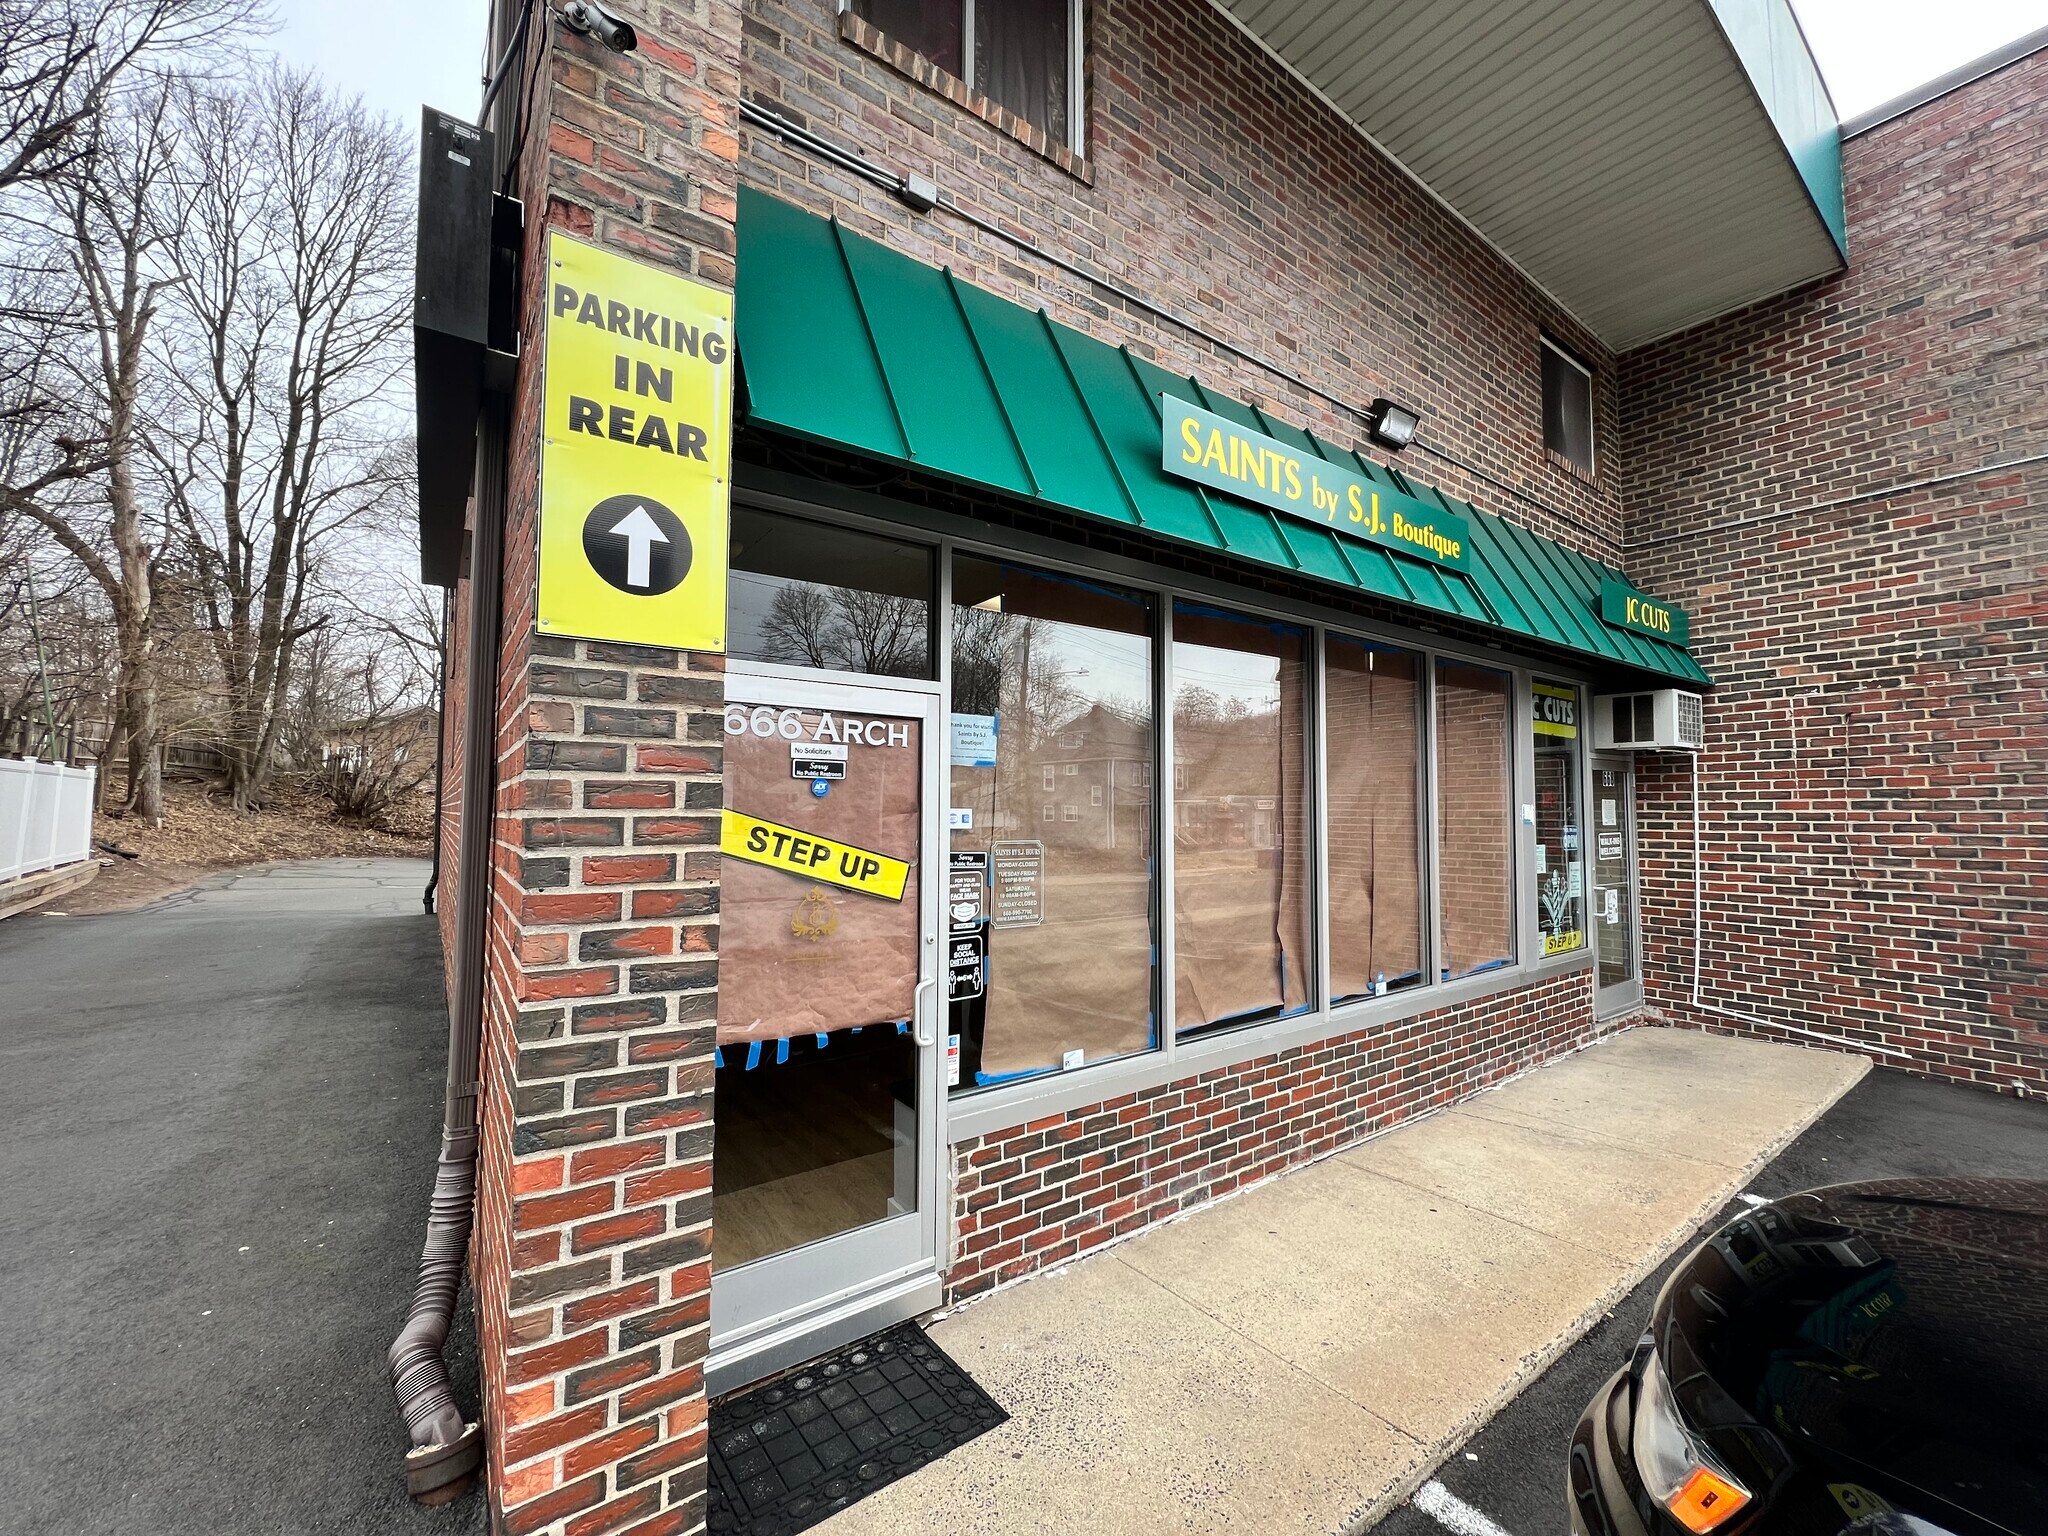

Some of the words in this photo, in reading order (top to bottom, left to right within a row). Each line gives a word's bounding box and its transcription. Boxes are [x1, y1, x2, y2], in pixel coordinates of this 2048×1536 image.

[554, 282, 727, 365] PARKING
[614, 354, 673, 404] IN
[569, 394, 709, 463] REAR
[1180, 417, 1302, 501] SAINTS
[1312, 476, 1340, 522] by
[1347, 484, 1386, 536] S.J.
[1393, 511, 1460, 560] Boutique
[1626, 596, 1639, 624] JC
[1641, 602, 1670, 634] CUTS
[1532, 694, 1540, 720] C
[1543, 696, 1574, 725] CUTS
[723, 703, 803, 740] 666
[804, 747, 832, 755] Solicitors
[809, 761, 829, 772] Sorry
[819, 770, 842, 778] Restroom
[813, 782, 828, 791] ADT
[747, 826, 831, 868] STEP
[839, 852, 880, 881] UP
[1025, 848, 1041, 856] HOURS
[1600, 847, 1621, 856] WELCOME
[957, 853, 974, 862] Sorry
[997, 870, 1038, 878] TUESDAY-FRIDAY
[951, 892, 964, 900] FACE
[964, 891, 980, 899] MASK
[997, 900, 1038, 908] SUNDAY-CLOSED
[957, 943, 973, 951] KEEP
[1548, 935, 1566, 949] STEP
[953, 949, 976, 958] SOCIAL
[950, 955, 980, 967] DISTANCE
